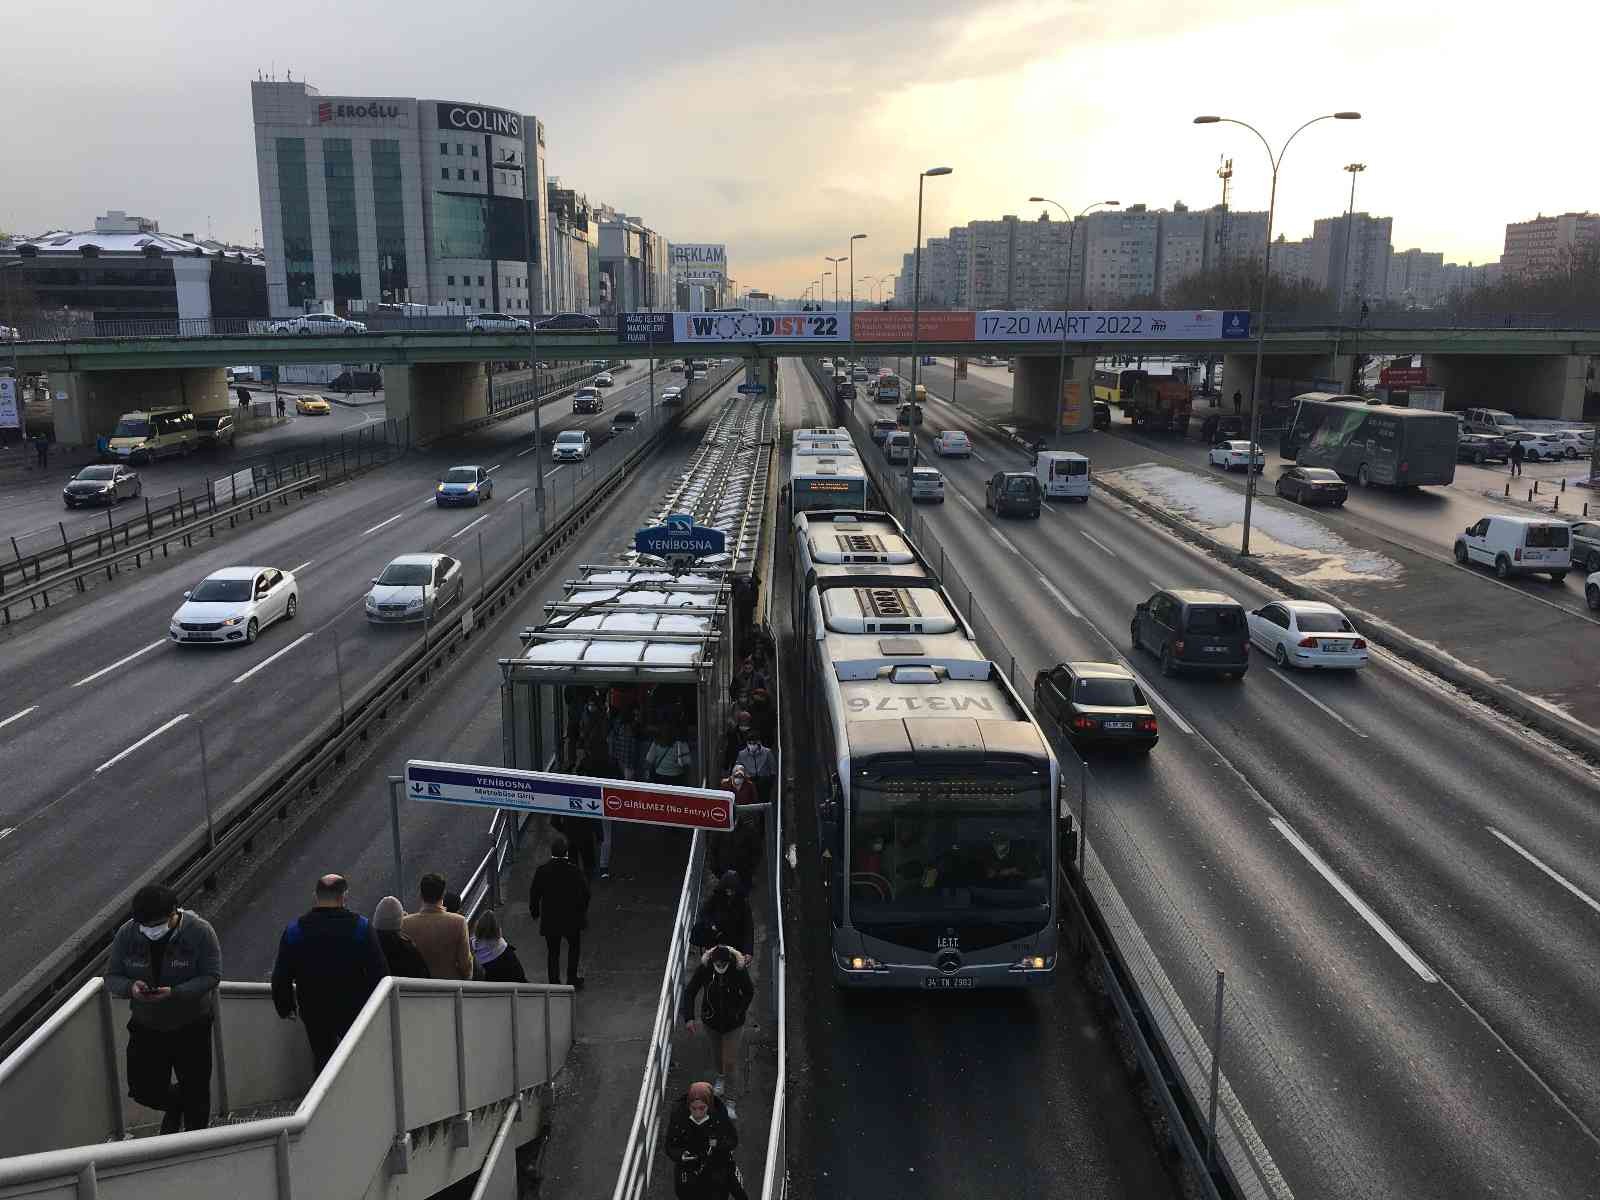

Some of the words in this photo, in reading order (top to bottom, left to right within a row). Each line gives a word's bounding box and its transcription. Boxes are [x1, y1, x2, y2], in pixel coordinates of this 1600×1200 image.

[337, 102, 399, 119] EROĞLU
[450, 107, 519, 136] COLIN'S
[675, 247, 721, 262] REKLAM
[981, 316, 1030, 334] 17-20
[1036, 316, 1090, 334] MART
[1095, 316, 1143, 334] 2022
[648, 537, 712, 550] YENİBOSNA
[847, 695, 994, 713] M3176
[476, 777, 532, 790] YENİBOSNA
[623, 799, 665, 812] GİRİLMEZ
[666, 803, 682, 814] (No
[684, 808, 710, 819] Entry)
